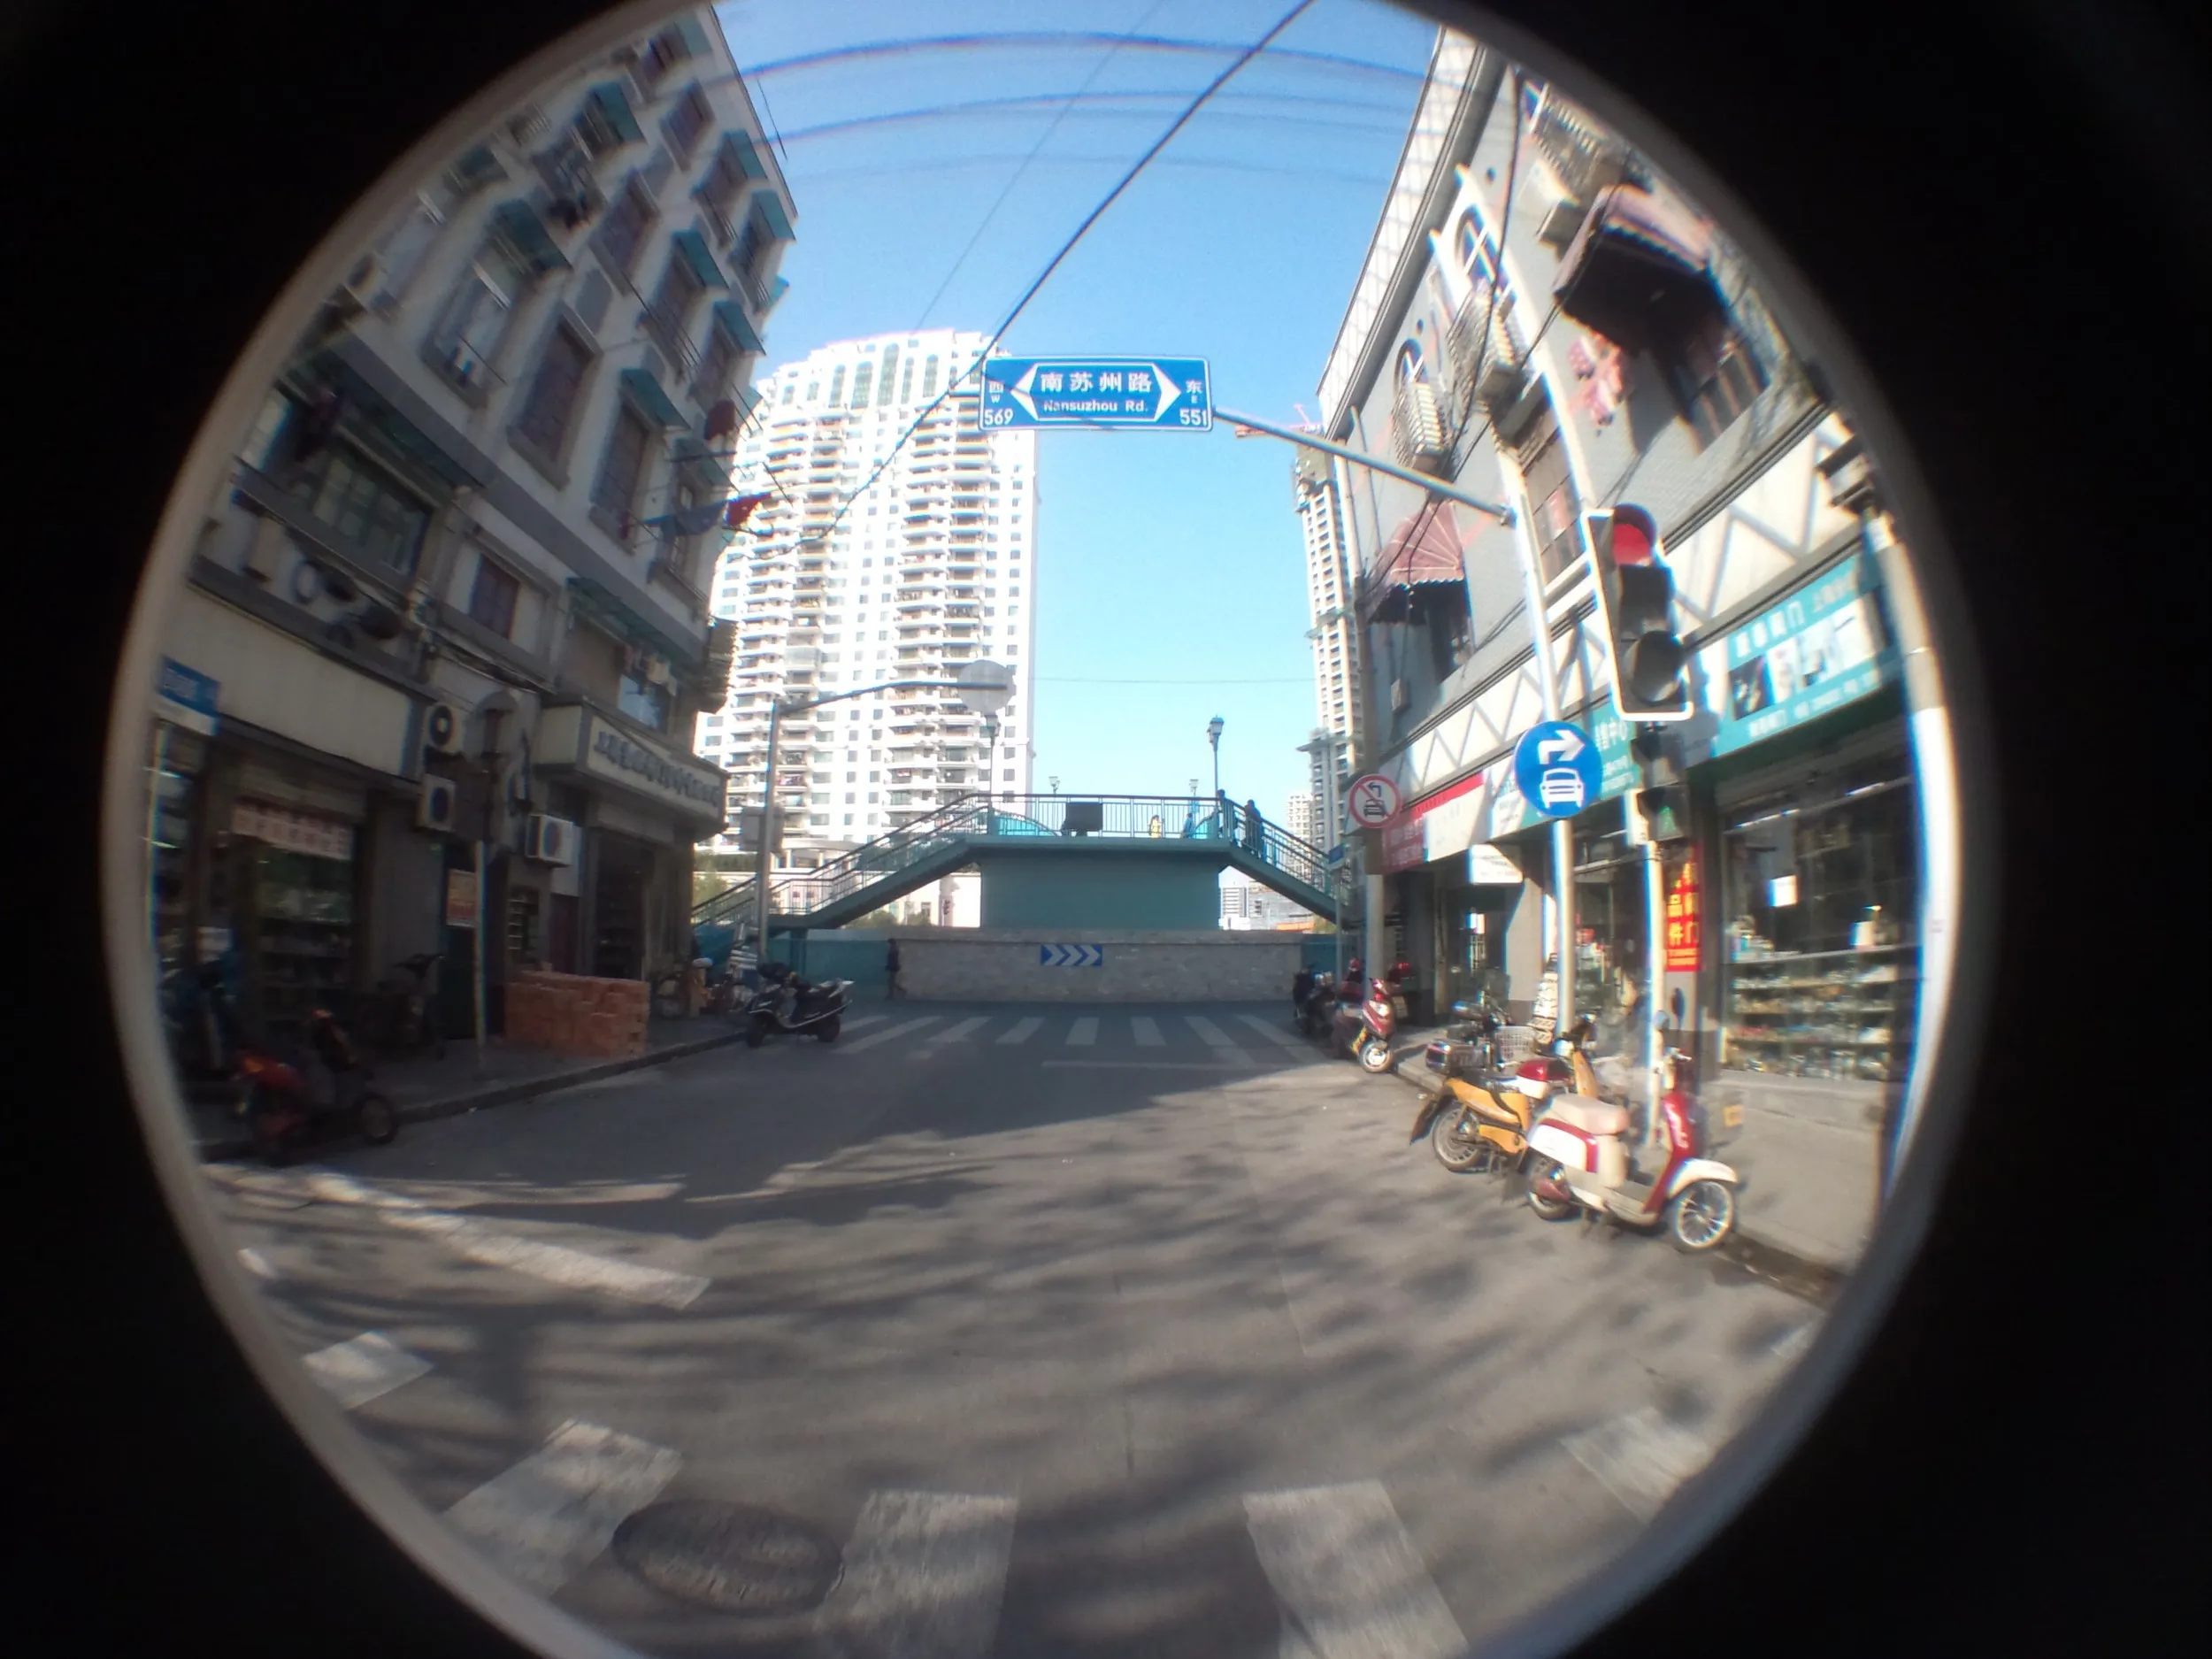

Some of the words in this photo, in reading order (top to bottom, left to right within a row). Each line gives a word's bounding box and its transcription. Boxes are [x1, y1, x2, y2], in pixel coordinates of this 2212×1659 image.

[1041, 372, 1152, 393] 南苏州路
[1186, 379, 1202, 394] 东
[991, 395, 1001, 403] W
[1044, 399, 1118, 411] Nansuzhou
[984, 408, 1014, 426] 569
[1179, 408, 1207, 426] 551
